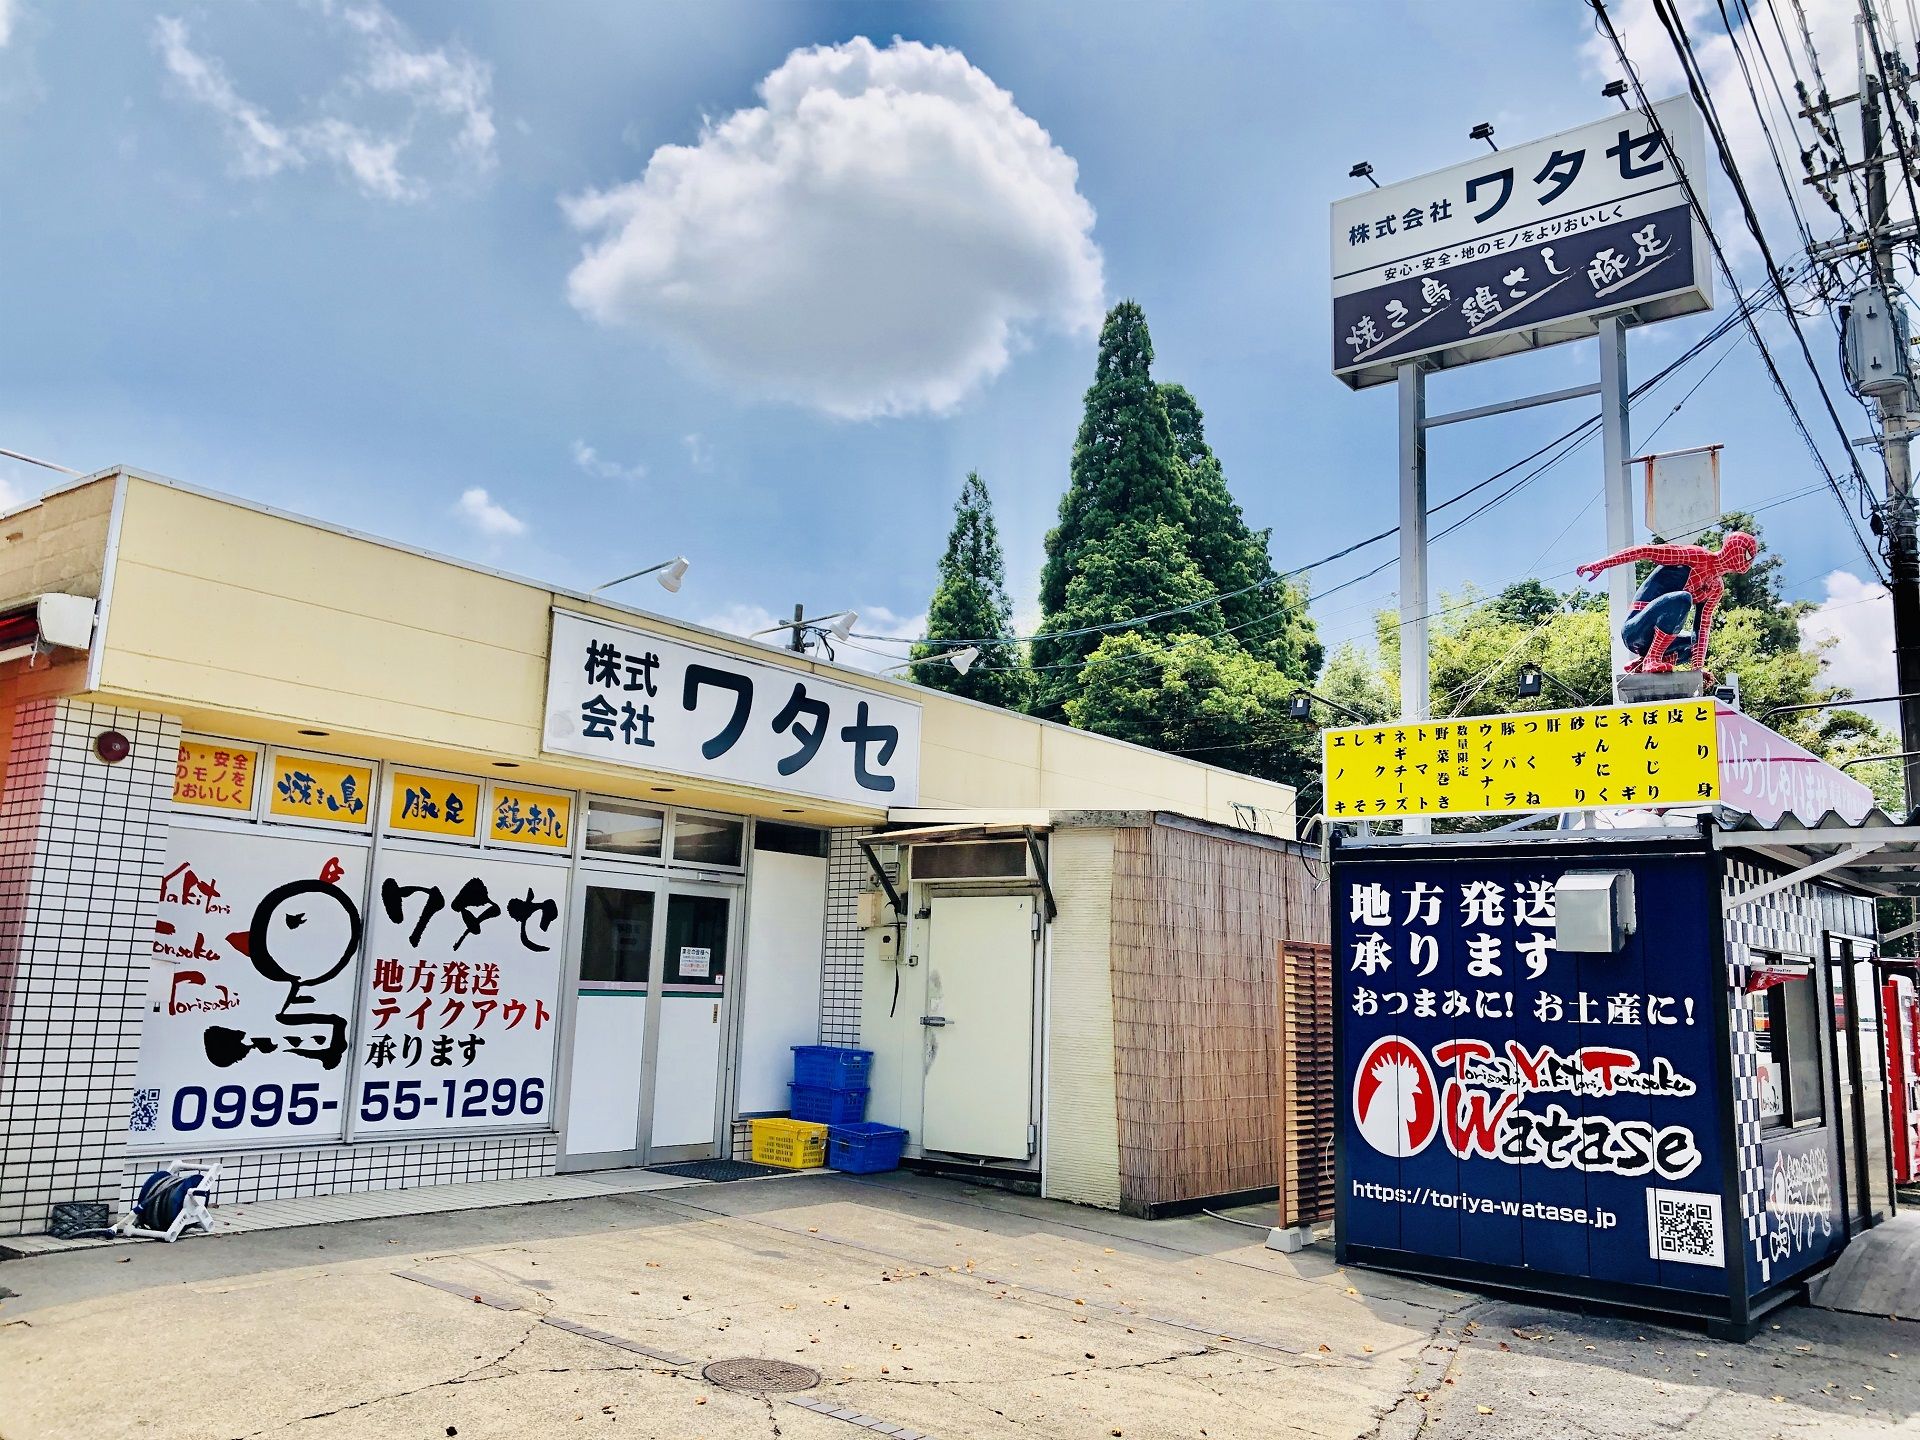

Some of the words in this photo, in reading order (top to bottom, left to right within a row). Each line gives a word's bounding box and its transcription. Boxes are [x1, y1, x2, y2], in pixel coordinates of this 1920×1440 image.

[1349, 198, 1452, 246] 株式会社
[1466, 129, 1665, 223] ワタセ
[1385, 205, 1623, 280] 安心・安全・地のモノをよりおいしく
[1587, 224, 1673, 291] 豚足
[1346, 277, 1451, 352] 焼き鳥
[584, 639, 660, 698] 株式
[582, 694, 656, 748] 会社
[682, 663, 898, 792] ワタセ
[1457, 725, 1469, 777] 数量限定
[1546, 718, 1561, 733] 肝
[1667, 708, 1683, 724] 皮
[1695, 707, 1713, 798] とり身
[1333, 736, 1347, 814] エノキ
[1354, 733, 1366, 813] しそ
[1373, 732, 1387, 812] オクラ
[1394, 730, 1408, 811] ネギチーズ
[1415, 728, 1428, 810] トマト
[1435, 727, 1450, 809] 野菜巻き
[1479, 723, 1494, 807] ウィンナー
[1501, 722, 1517, 806] 豚バラ
[1524, 722, 1541, 805] つくね
[1570, 716, 1586, 803] 砂ずり
[1594, 715, 1610, 802] にんにく
[1619, 712, 1637, 801] ネギ
[1642, 709, 1660, 800] ぼんじり
[277, 770, 364, 815] 焼き鳥
[402, 786, 464, 824] 豚足
[495, 796, 564, 839] 鶏刺し
[381, 877, 558, 952] ワタセ
[1349, 880, 1557, 928] 地方発送
[373, 959, 500, 995] 地方発送
[1349, 932, 1557, 980] 承ります
[371, 997, 551, 1031] テイクアウト
[1352, 987, 1514, 1019] おつまみに!
[1534, 989, 1696, 1026] お土産に!
[364, 1033, 486, 1069] 承ります
[1446, 1082, 1694, 1173] Watase
[1352, 1179, 1617, 1229] https://toriya-watase.jp
